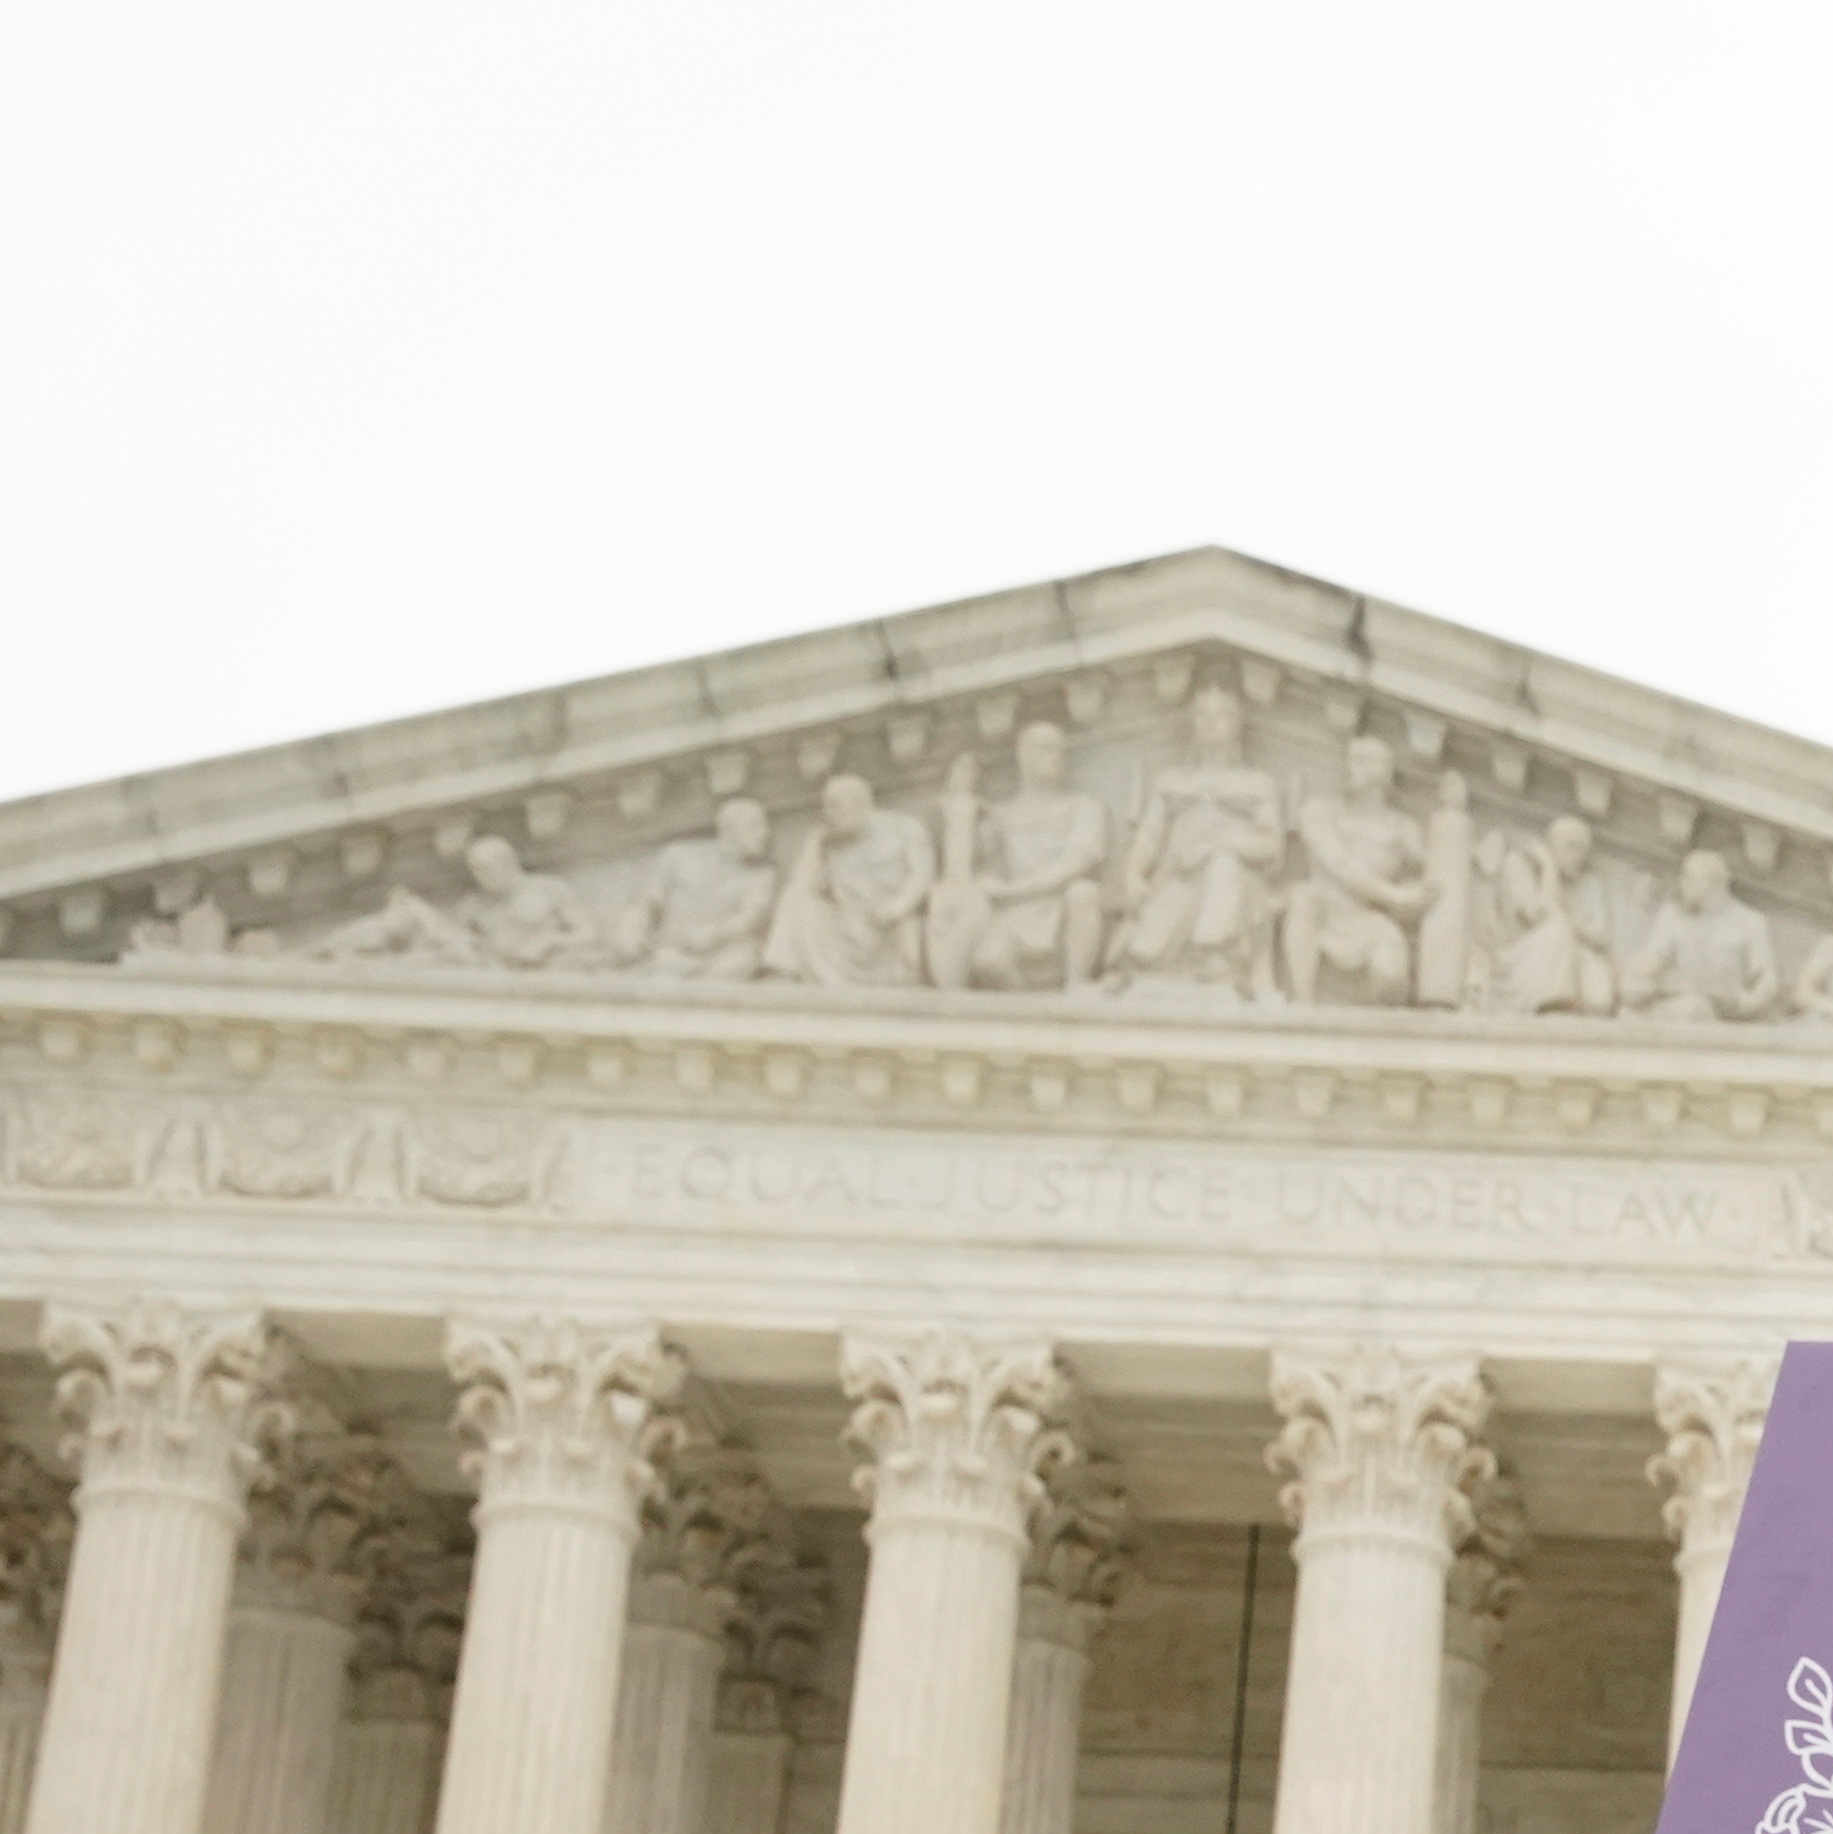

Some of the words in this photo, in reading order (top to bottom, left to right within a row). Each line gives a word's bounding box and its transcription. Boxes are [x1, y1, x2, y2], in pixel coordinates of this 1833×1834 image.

[632, 1142, 901, 1211] EQUAL
[920, 1153, 1231, 1222] JUSTICE
[1273, 1170, 1532, 1234] UNDER
[1570, 1180, 1722, 1238] LAW
